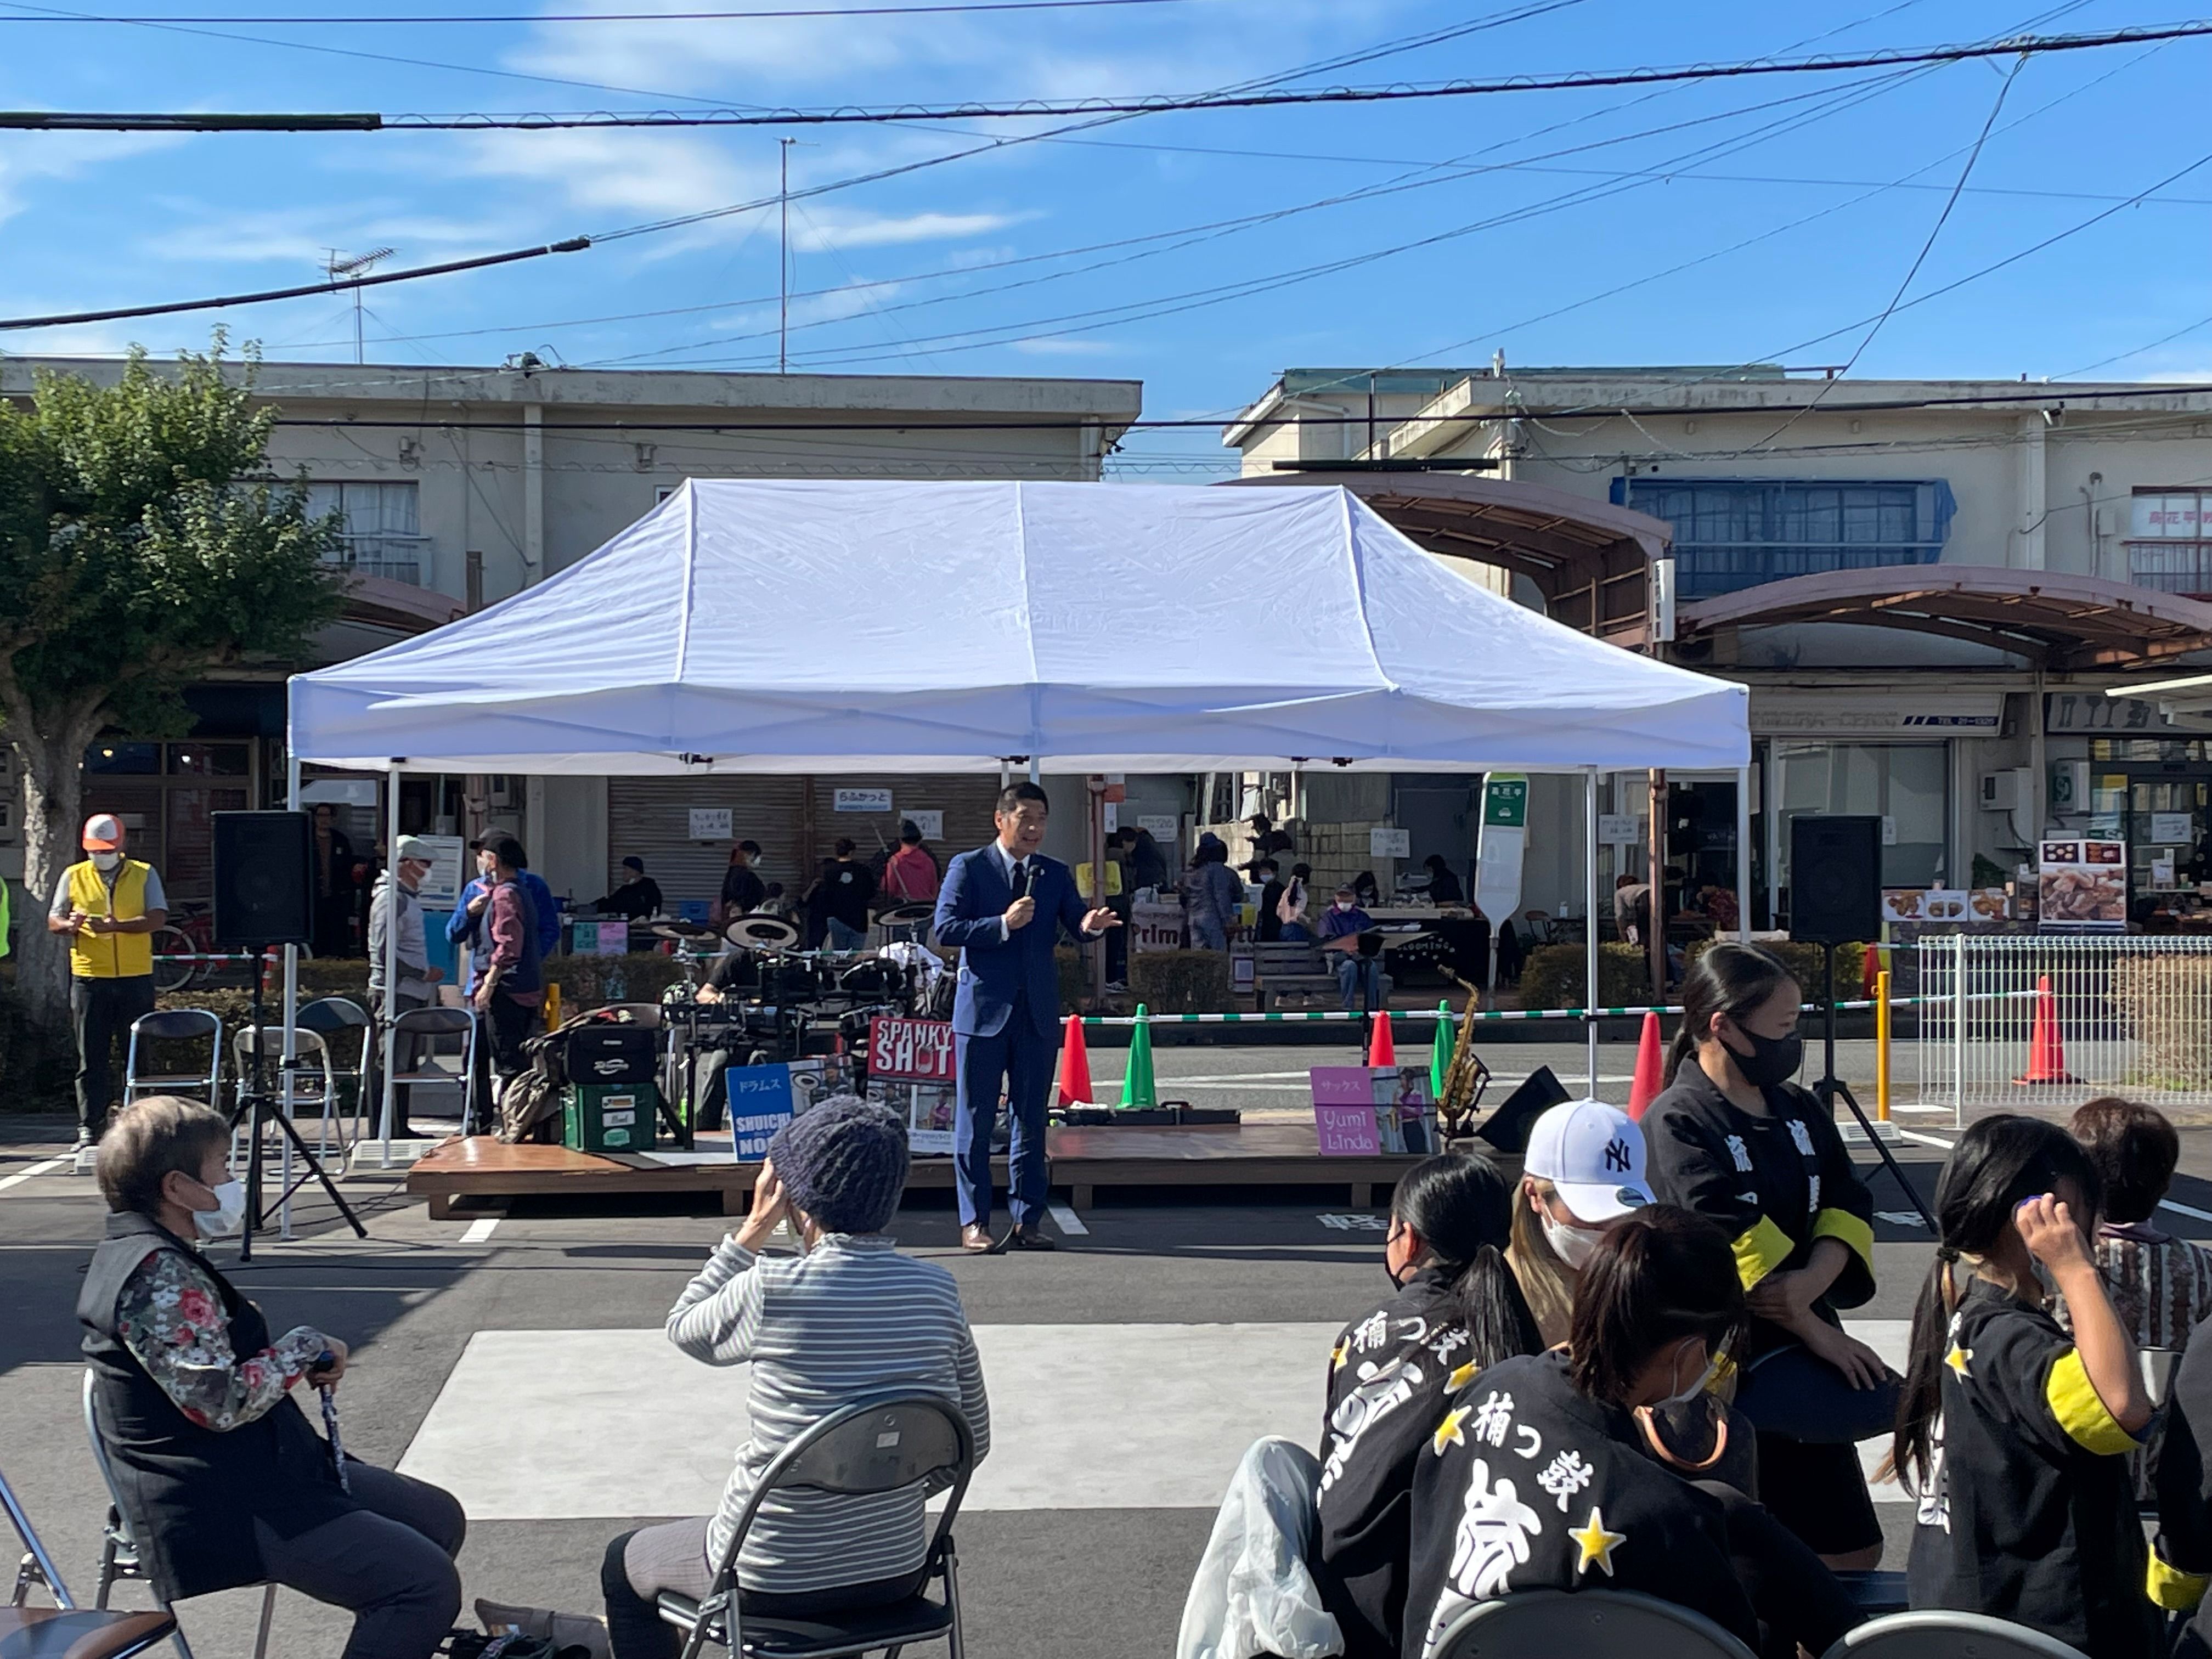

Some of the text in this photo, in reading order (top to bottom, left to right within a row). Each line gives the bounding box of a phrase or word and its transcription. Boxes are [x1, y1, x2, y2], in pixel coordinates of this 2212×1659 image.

[878, 1019, 952, 1044] SPANKY
[876, 1039, 952, 1075] SHOT
[739, 1078, 782, 1093] ドラムス
[1321, 1080, 1361, 1092] サックス
[736, 1111, 791, 1133] SHUICHI
[1323, 1110, 1367, 1130] Yumi
[739, 1137, 771, 1155] NO
[1327, 1133, 1374, 1150] Linda
[1605, 1137, 1631, 1172] NY
